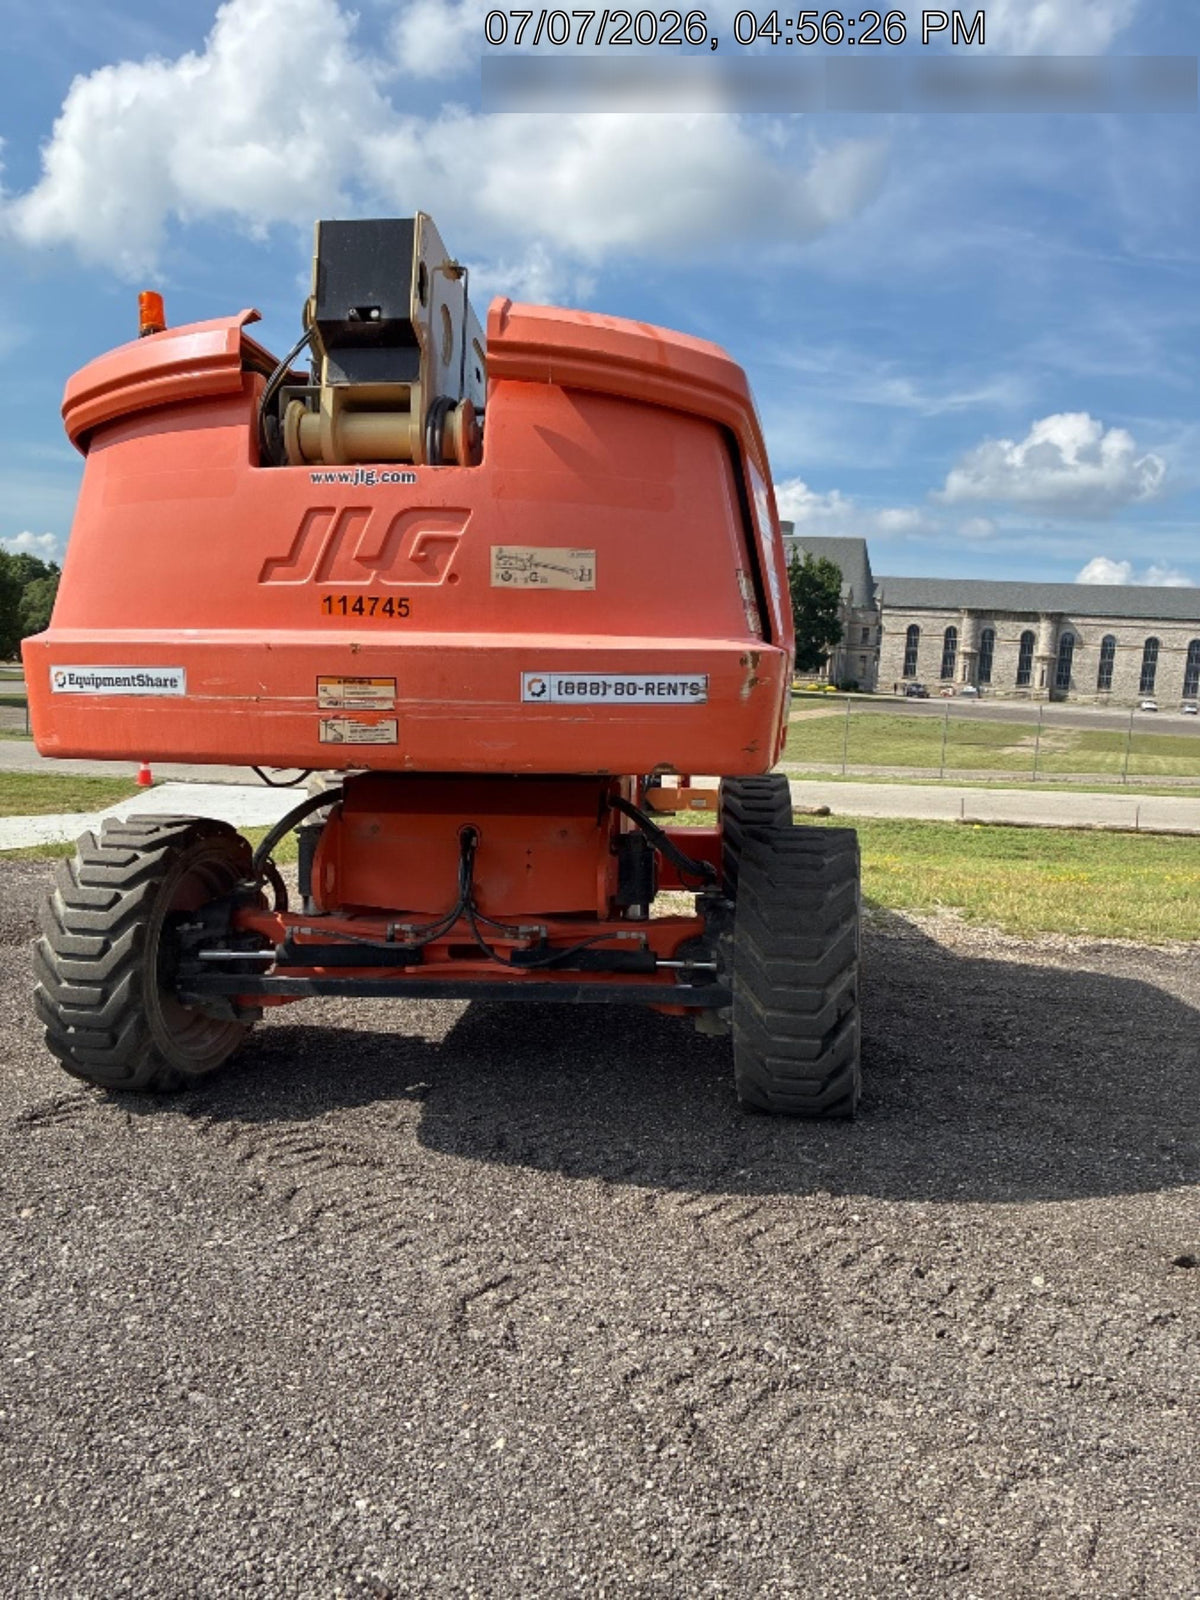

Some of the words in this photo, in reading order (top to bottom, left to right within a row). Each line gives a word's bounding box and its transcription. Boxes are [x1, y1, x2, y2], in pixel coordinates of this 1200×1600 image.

[310, 469, 417, 486] www.jlg.com
[322, 595, 411, 618] 114745
[67, 673, 179, 689] EquipmentShare
[613, 681, 701, 697] 80-RENTS
